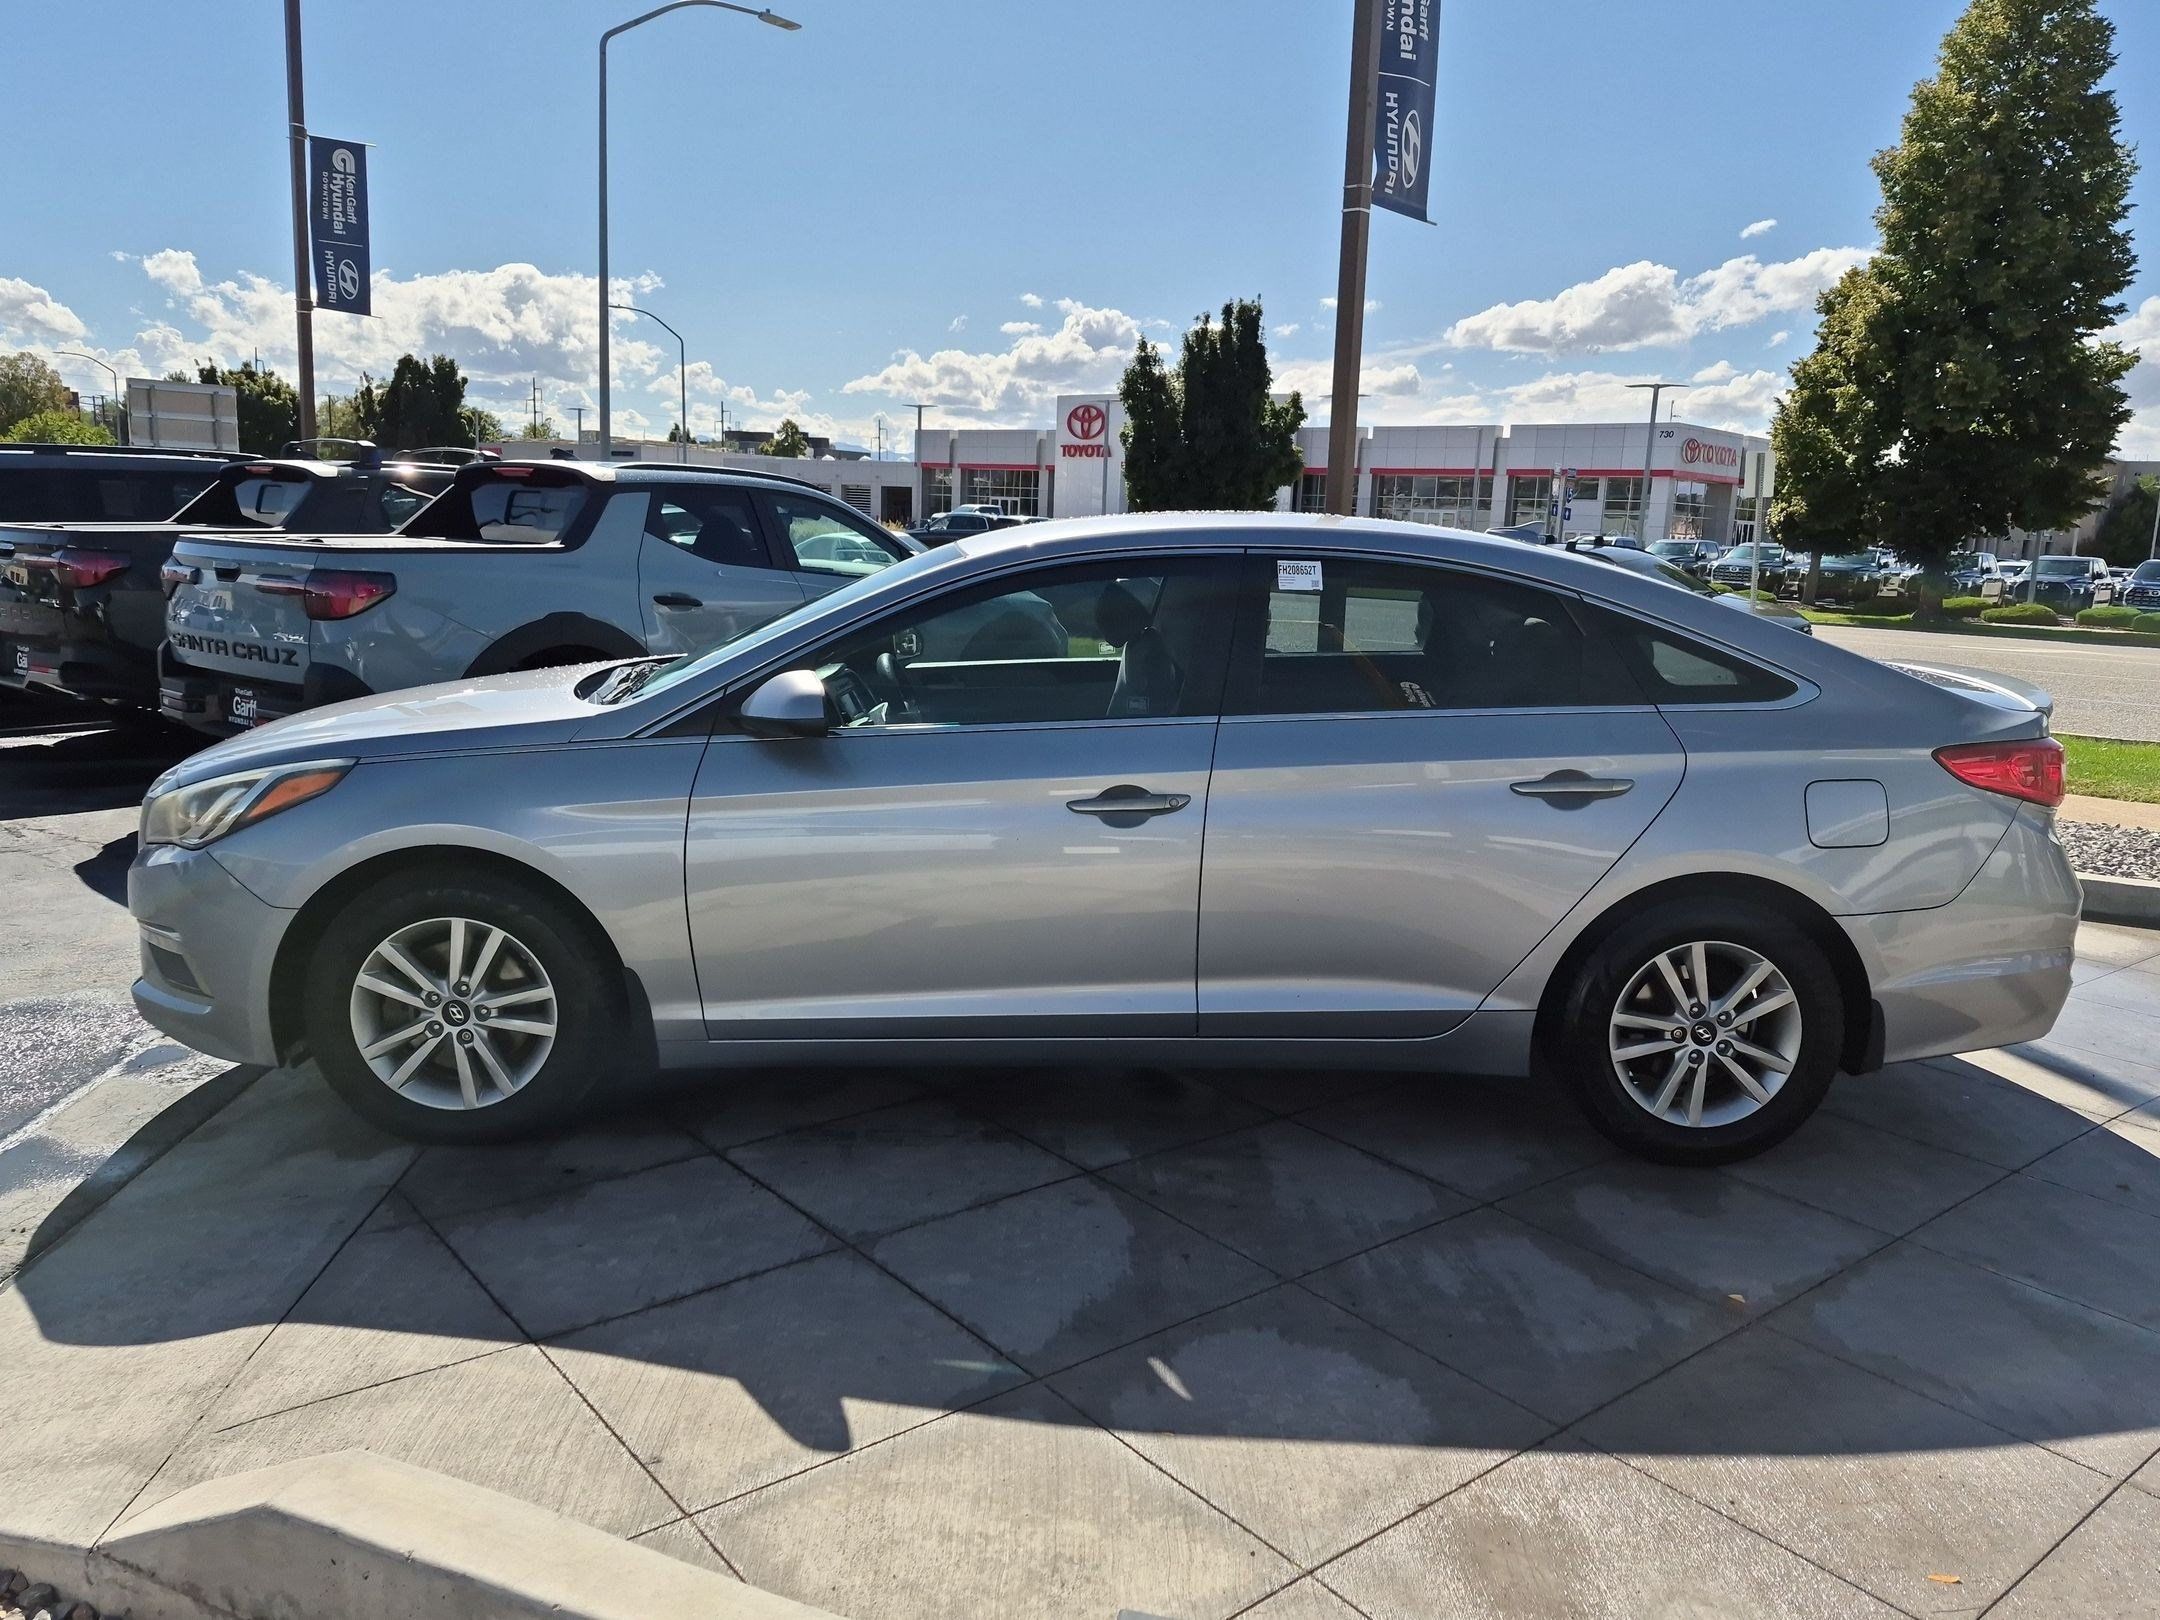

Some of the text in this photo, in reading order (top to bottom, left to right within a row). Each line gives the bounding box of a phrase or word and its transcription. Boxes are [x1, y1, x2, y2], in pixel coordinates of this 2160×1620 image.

[1400, 0, 1417, 60] ndai
[1385, 92, 1399, 194] HYUNDAI
[330, 174, 346, 235] Hyundai
[346, 175, 357, 225] Ken Garff
[324, 250, 337, 304] HYUNDAI
[1659, 430, 1675, 439] 730
[1699, 442, 1737, 467] TOYOTA
[172, 632, 300, 667] SANTA CRUZ
